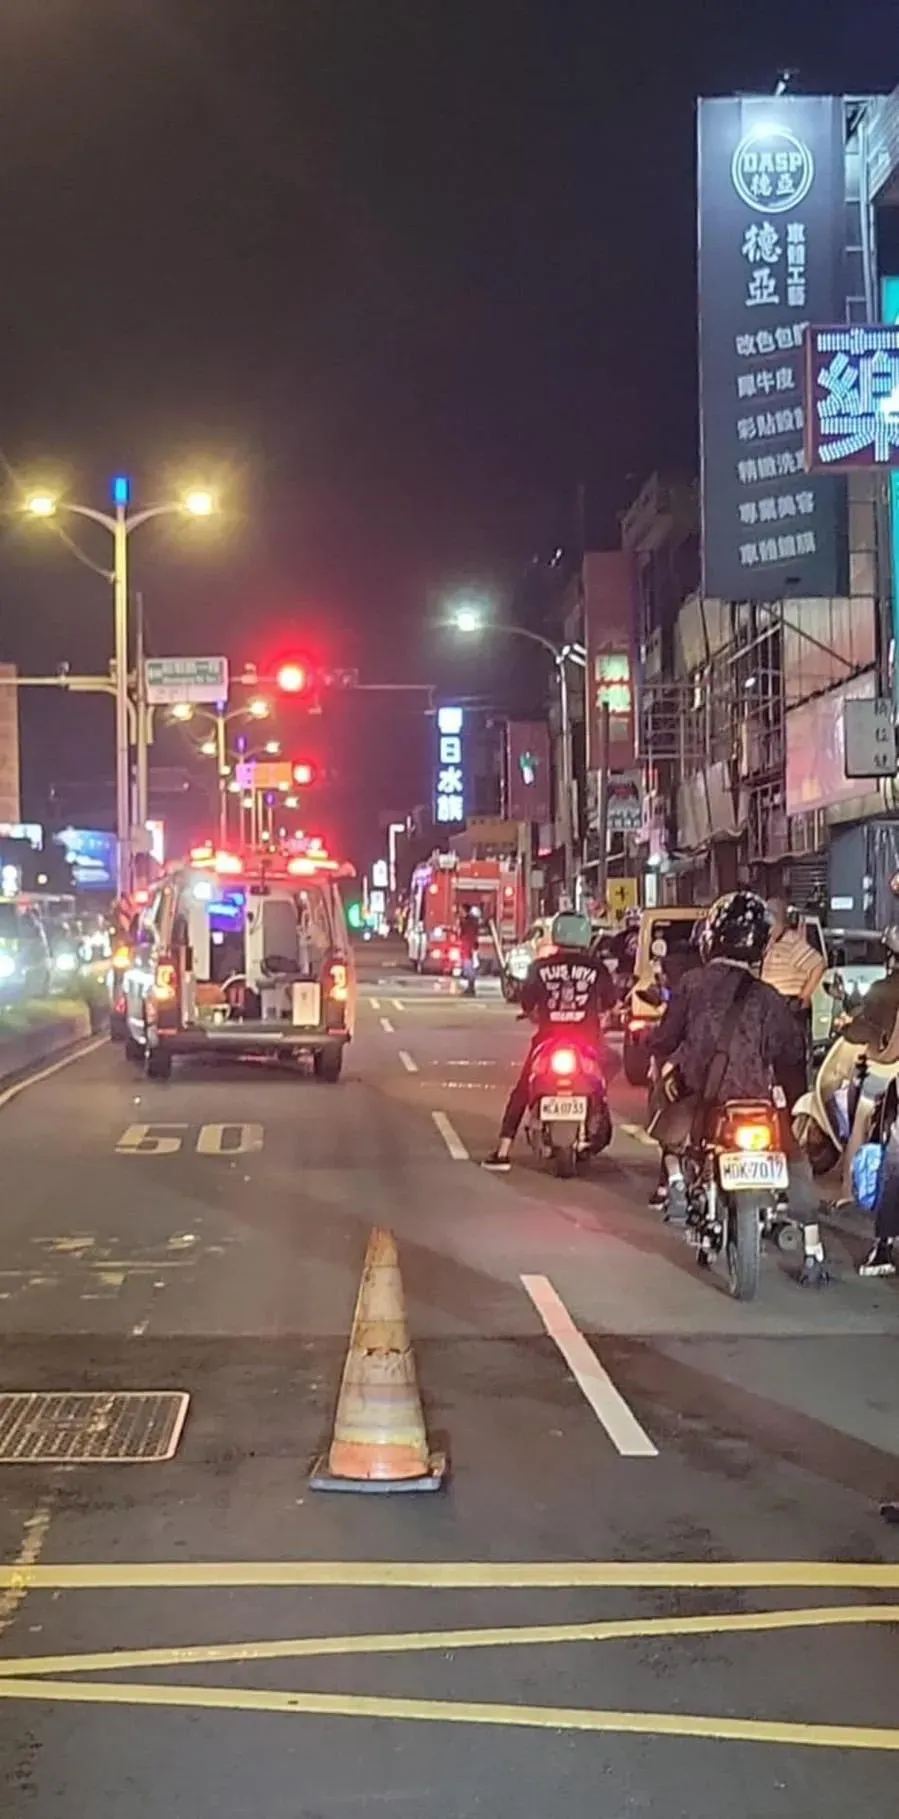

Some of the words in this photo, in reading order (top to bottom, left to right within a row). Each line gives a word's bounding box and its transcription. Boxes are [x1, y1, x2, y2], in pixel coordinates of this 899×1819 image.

[743, 152, 802, 172] DASP
[750, 173, 795, 196] 德亞
[742, 220, 783, 307] 德亞
[115, 1123, 263, 1154] 50
